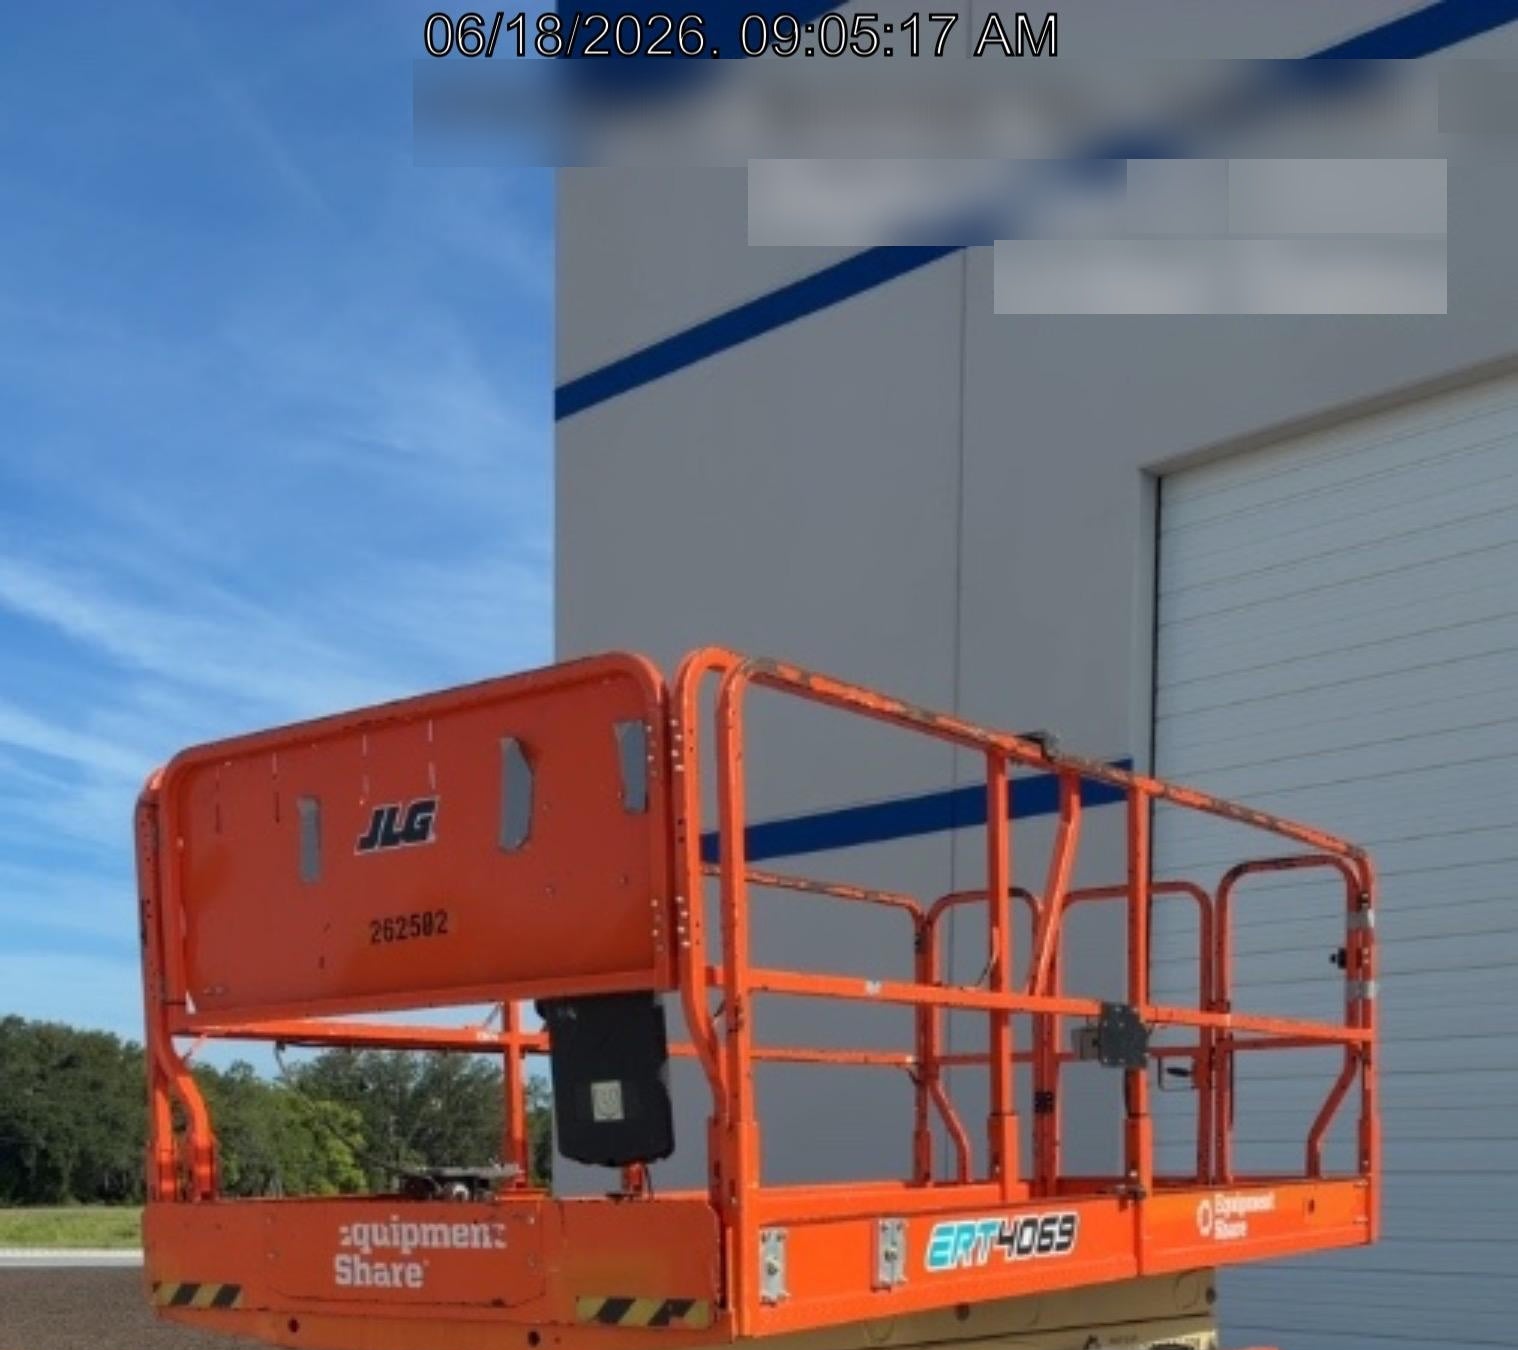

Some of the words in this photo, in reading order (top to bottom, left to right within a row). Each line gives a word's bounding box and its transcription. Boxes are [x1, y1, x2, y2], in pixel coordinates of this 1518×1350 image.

[354, 795, 439, 855] JLG
[370, 908, 449, 944] 262502
[334, 1253, 424, 1289] Share
